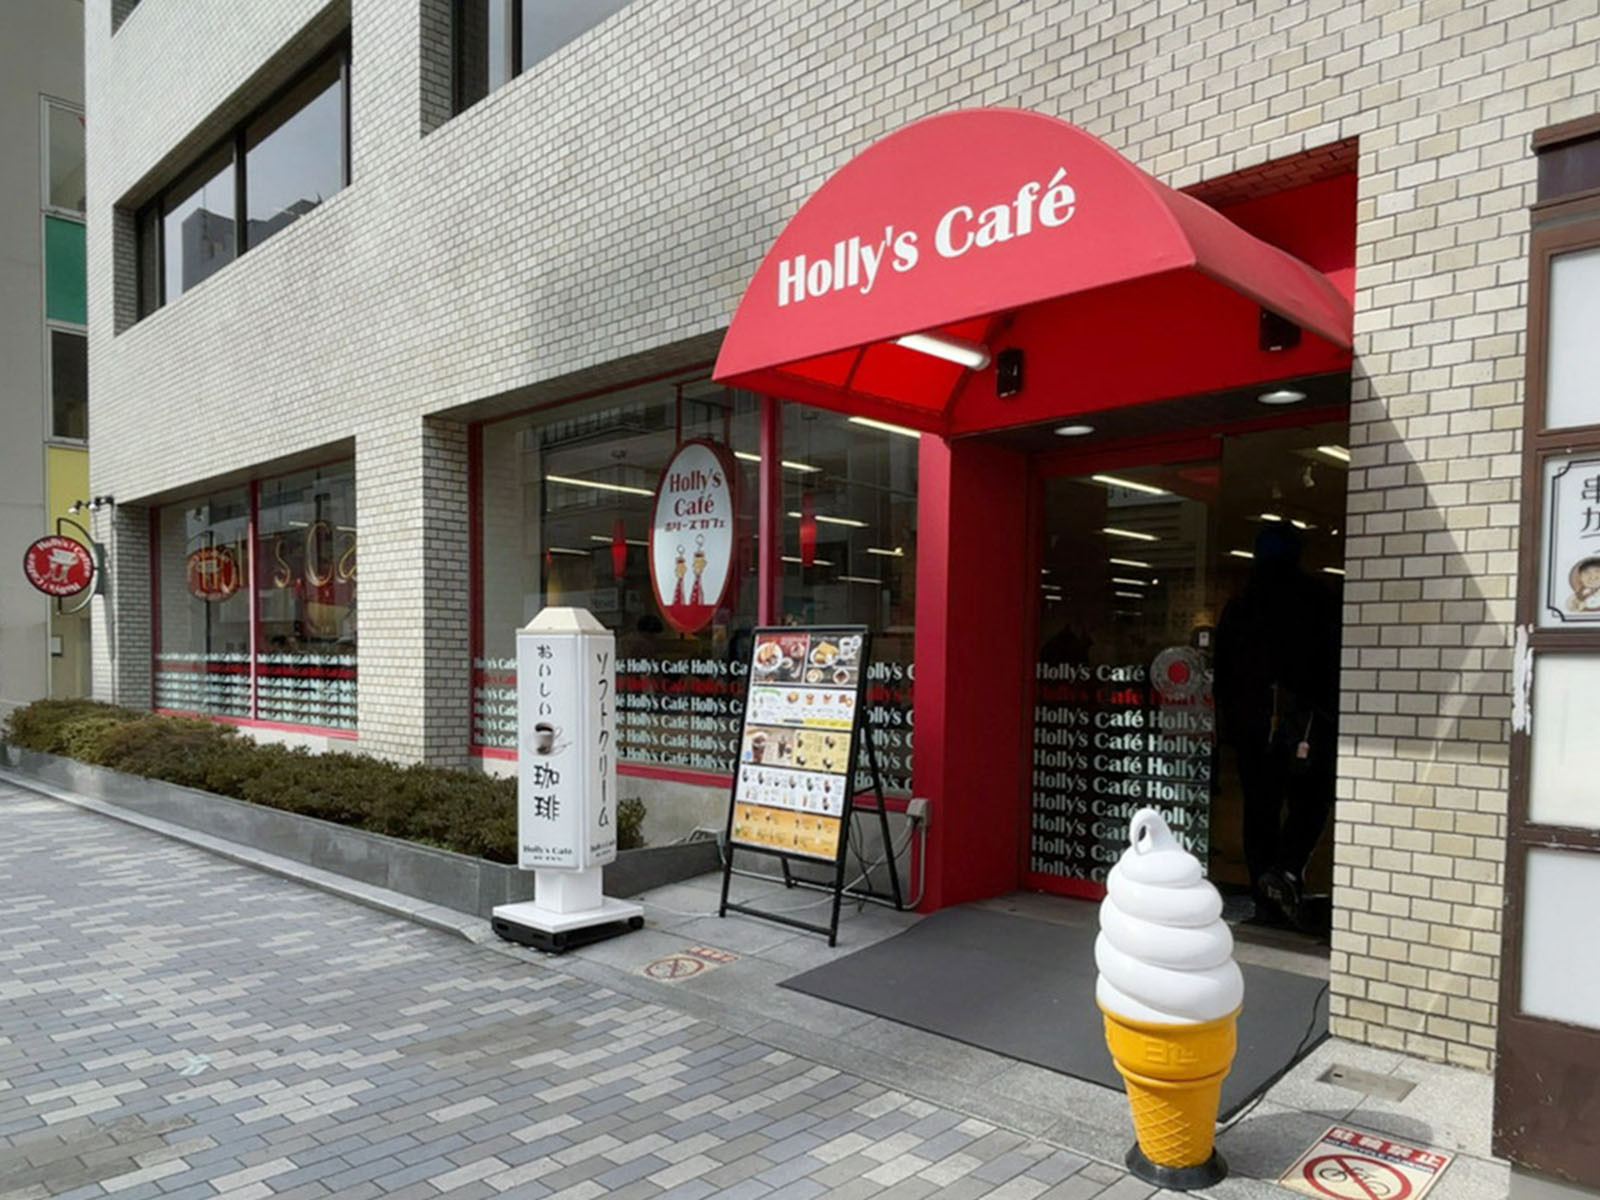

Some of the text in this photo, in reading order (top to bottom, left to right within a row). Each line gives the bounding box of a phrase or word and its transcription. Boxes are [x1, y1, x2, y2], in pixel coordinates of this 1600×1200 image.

[777, 166, 1077, 307] Holly's Café
[669, 468, 723, 495] Holly's
[674, 494, 715, 517] Café
[728, 660, 748, 676] Ca
[866, 662, 903, 683] olly's
[1035, 662, 1146, 683] Holly's Café
[533, 644, 560, 821] おいしい 珈琲
[1034, 705, 1213, 732] Holly's Café Holly's
[596, 652, 610, 828] ソフトクリーム
[1033, 726, 1212, 757] Holly's Café Holly's
[1033, 748, 1211, 782] Holly's Café Holly's
[1032, 770, 1210, 806] Holly's Café Holly's
[1032, 792, 1087, 815] Holly's
[1146, 803, 1209, 831] olly's
[1032, 813, 1087, 837] Holly's
[1091, 821, 1130, 841] Caf
[1031, 835, 1122, 863] Holly's Ca
